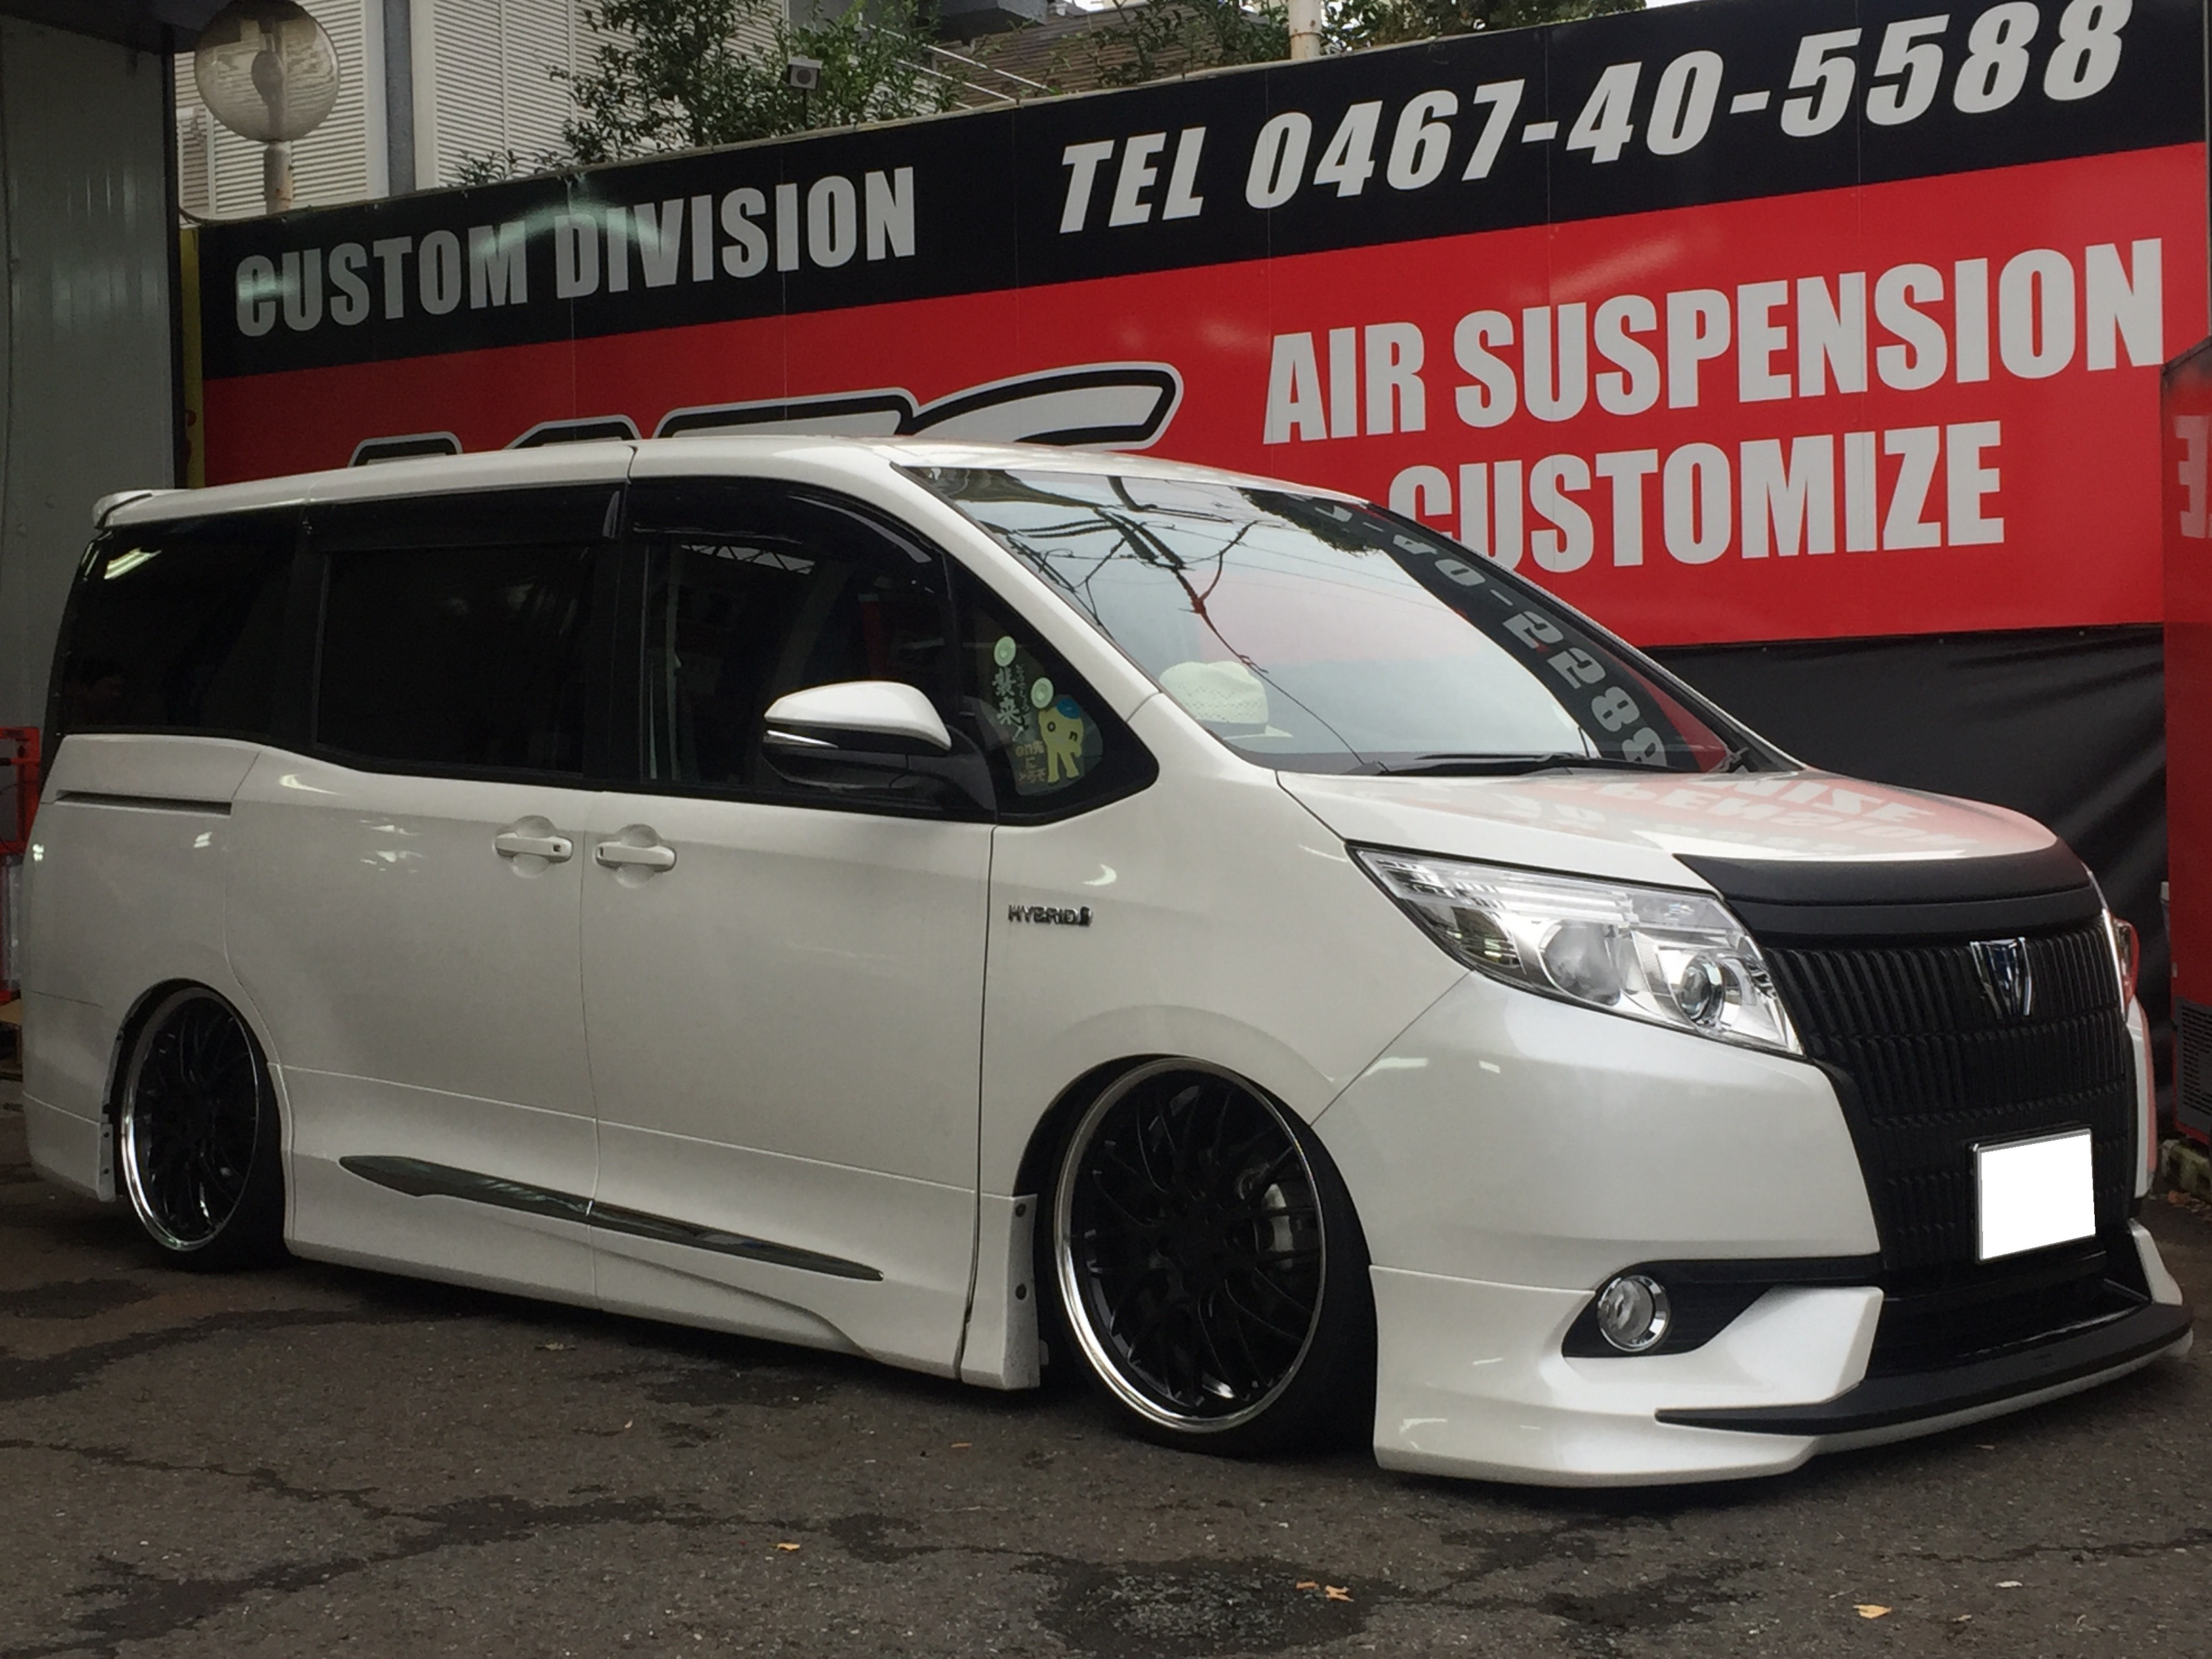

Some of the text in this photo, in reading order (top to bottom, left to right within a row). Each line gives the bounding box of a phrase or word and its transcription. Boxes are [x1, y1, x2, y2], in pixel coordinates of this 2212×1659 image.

[1060, 0, 2132, 232] TEL 0467-40-5588
[236, 167, 915, 337] CUSTOM DIVISION
[1264, 323, 1425, 445] AIR
[1454, 239, 2163, 428] SUSPENSION
[1389, 421, 2004, 574] CUSTOMIZE
[1008, 905, 1079, 924] HYBRID
